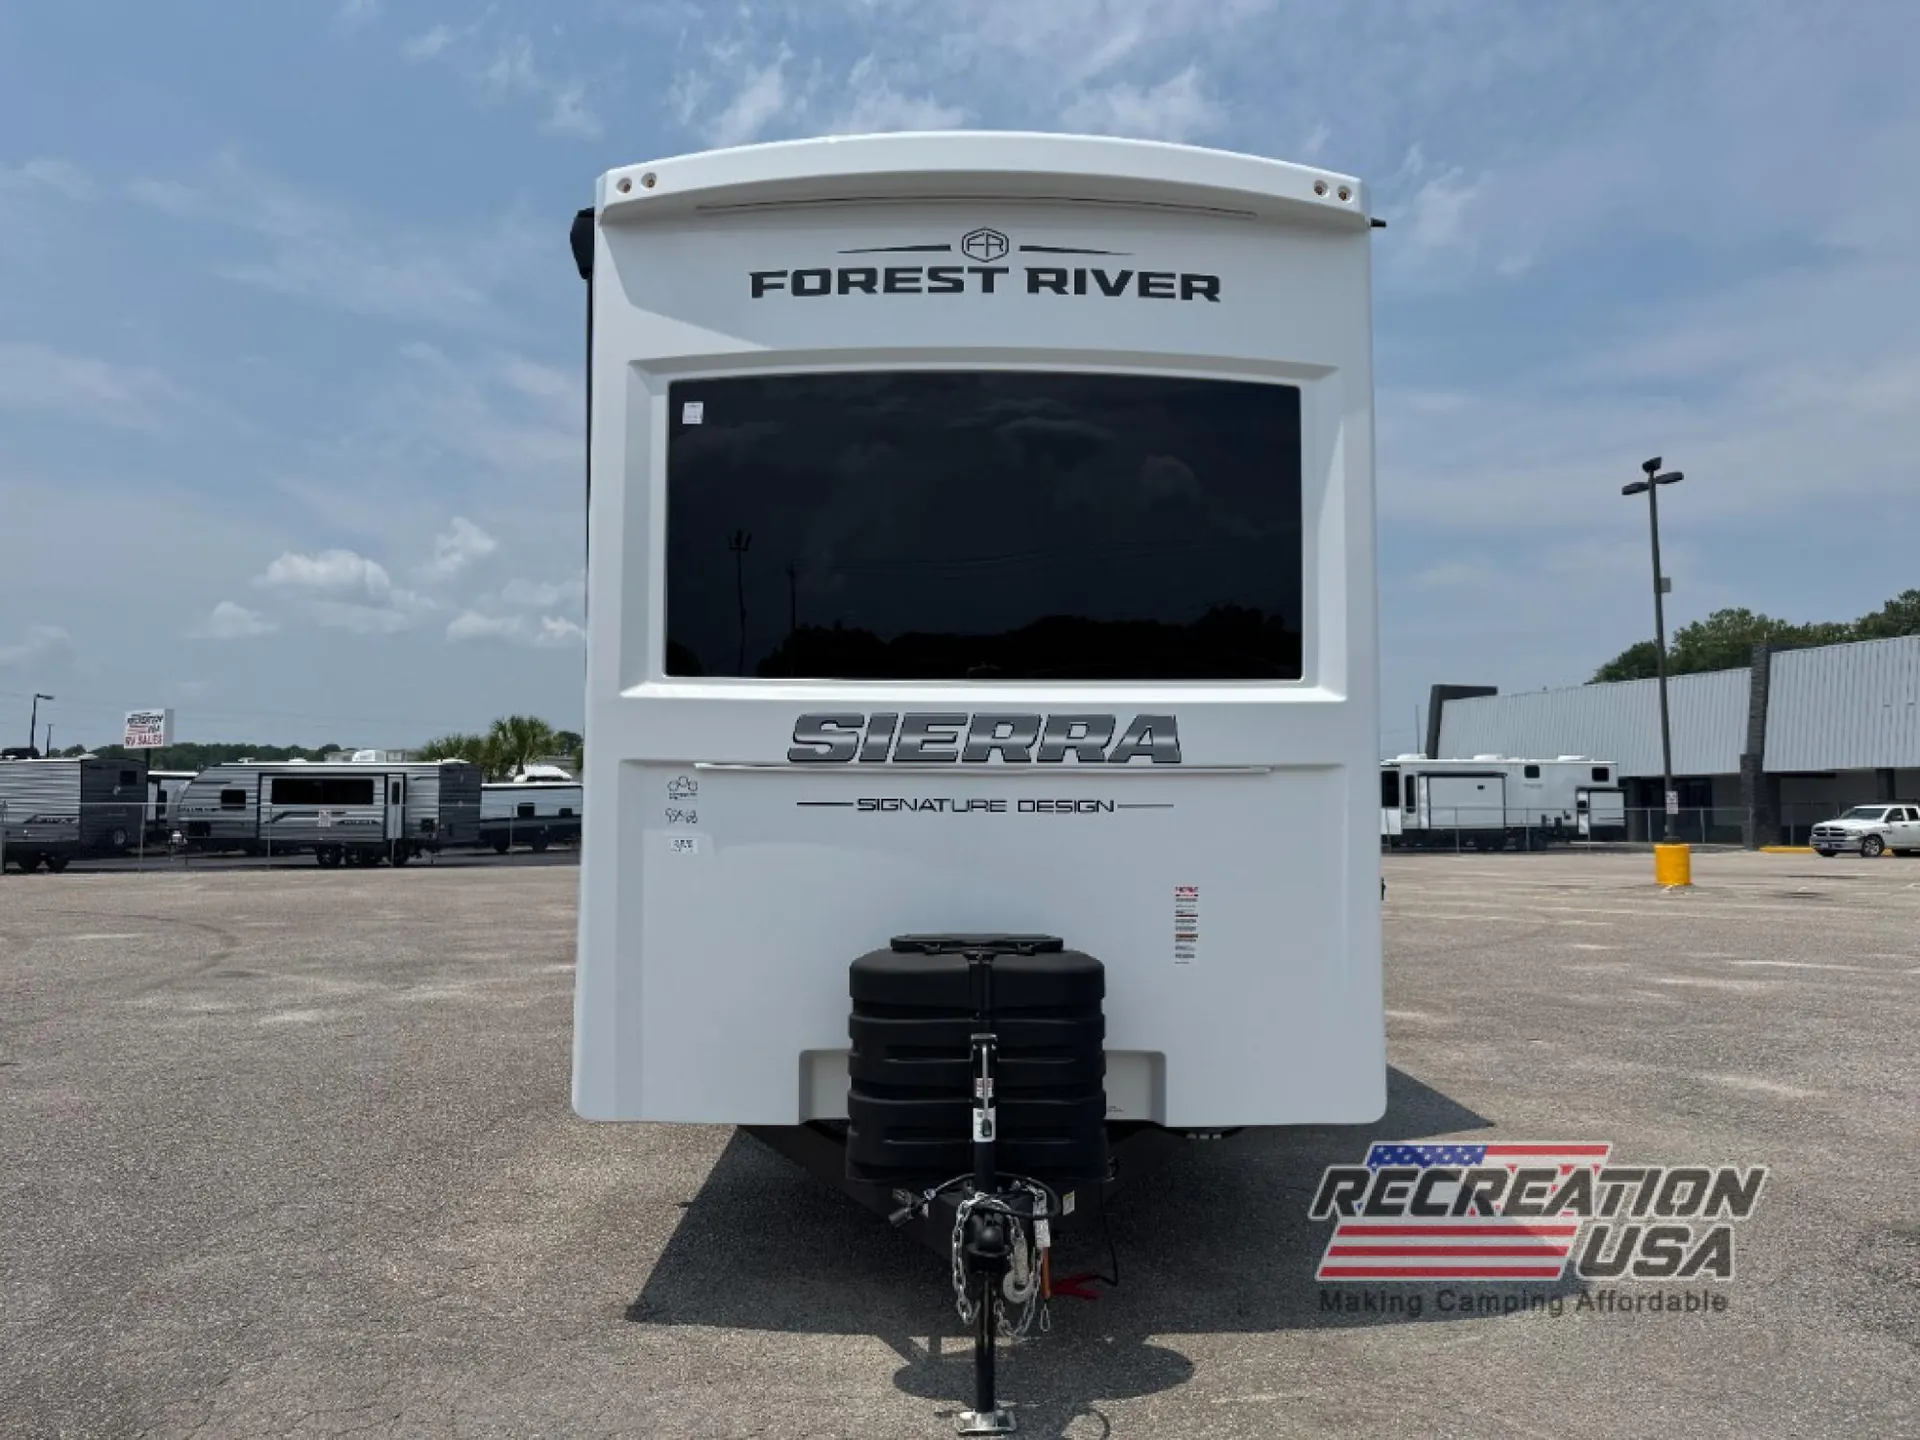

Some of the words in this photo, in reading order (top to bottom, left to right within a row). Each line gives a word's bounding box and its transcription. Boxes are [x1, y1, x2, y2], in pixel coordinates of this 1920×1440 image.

[748, 265, 1010, 299] FOREST
[1023, 266, 1221, 302] RIVER
[787, 712, 1182, 764] SIERRA
[857, 798, 1008, 813] SIGNATURE
[1017, 799, 1115, 813] DESIGN
